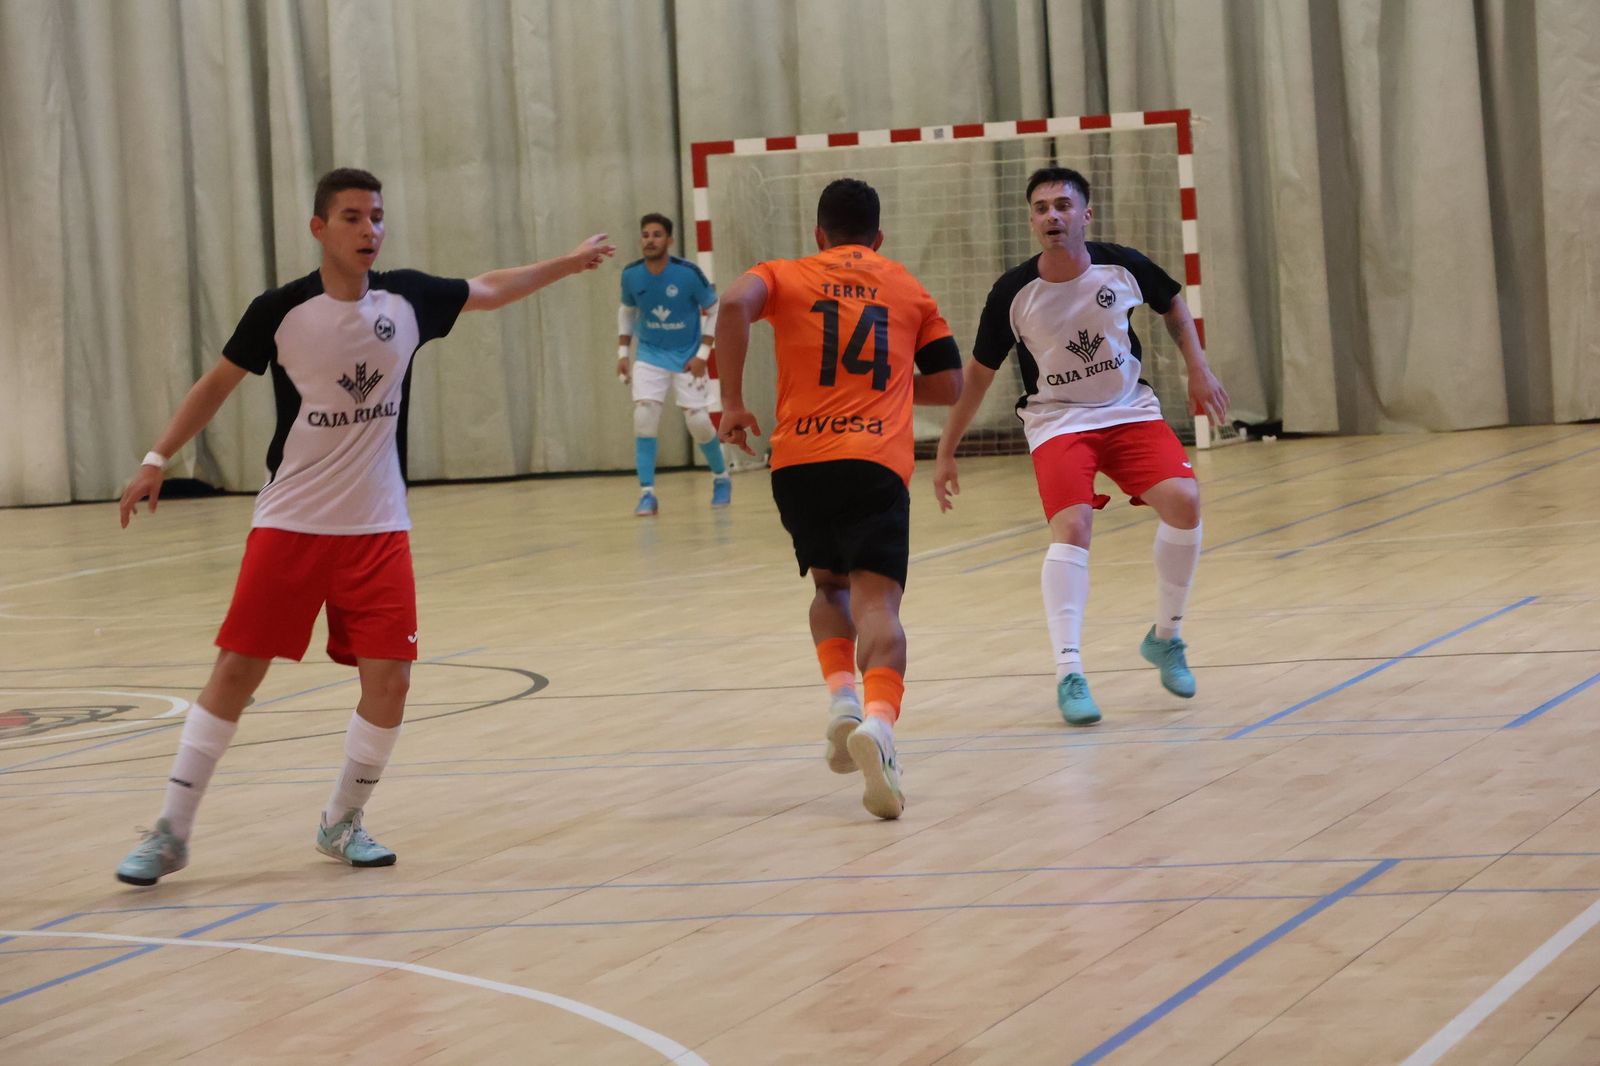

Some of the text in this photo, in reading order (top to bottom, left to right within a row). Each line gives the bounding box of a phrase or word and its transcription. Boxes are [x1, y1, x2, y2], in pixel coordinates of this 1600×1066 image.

[821, 282, 878, 300] TERRY
[809, 298, 891, 391] 14
[1046, 352, 1125, 386] CAJA RURAL
[307, 411, 350, 428] CAJA
[795, 415, 883, 436] uvesa
